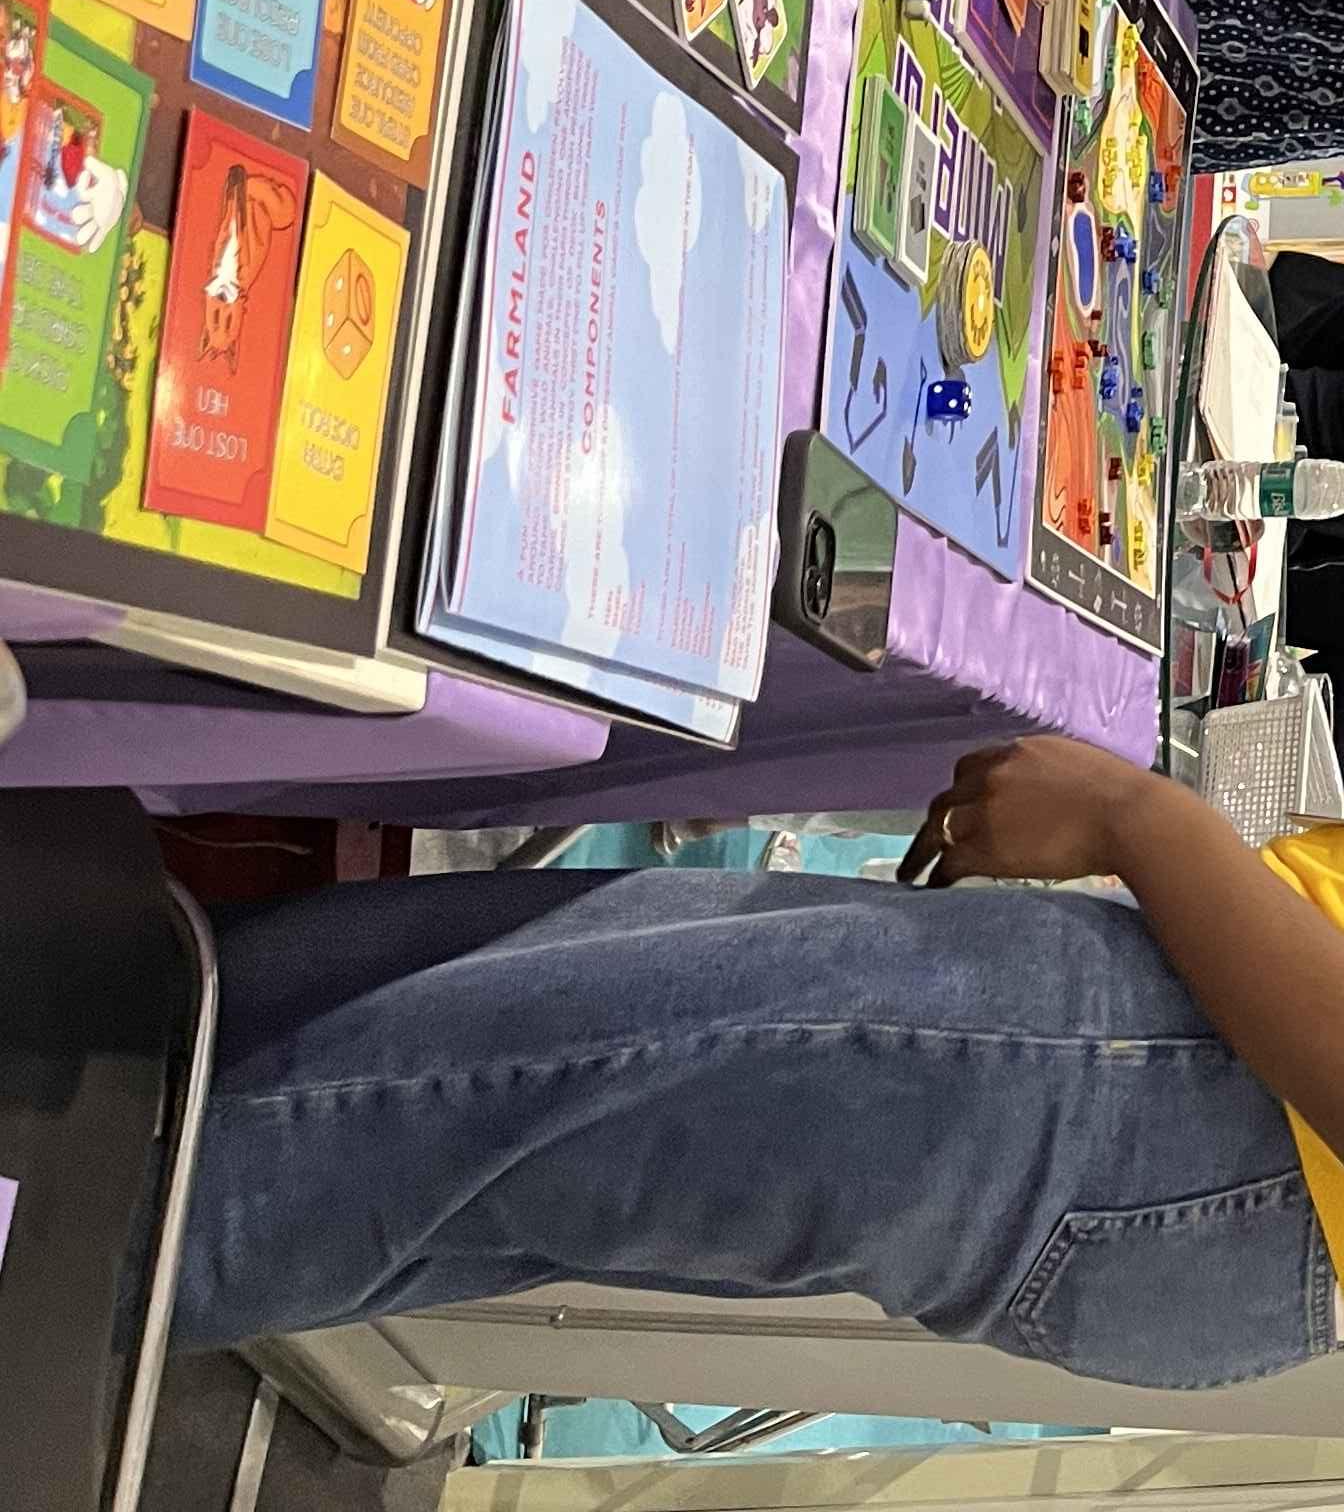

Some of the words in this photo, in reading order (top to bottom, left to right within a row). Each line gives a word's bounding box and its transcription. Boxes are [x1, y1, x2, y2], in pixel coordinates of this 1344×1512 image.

[499, 145, 539, 426] FARMLAND
[577, 196, 611, 455] COMPONENTS
[196, 385, 231, 416] HEN
[206, 431, 248, 462] LOST
